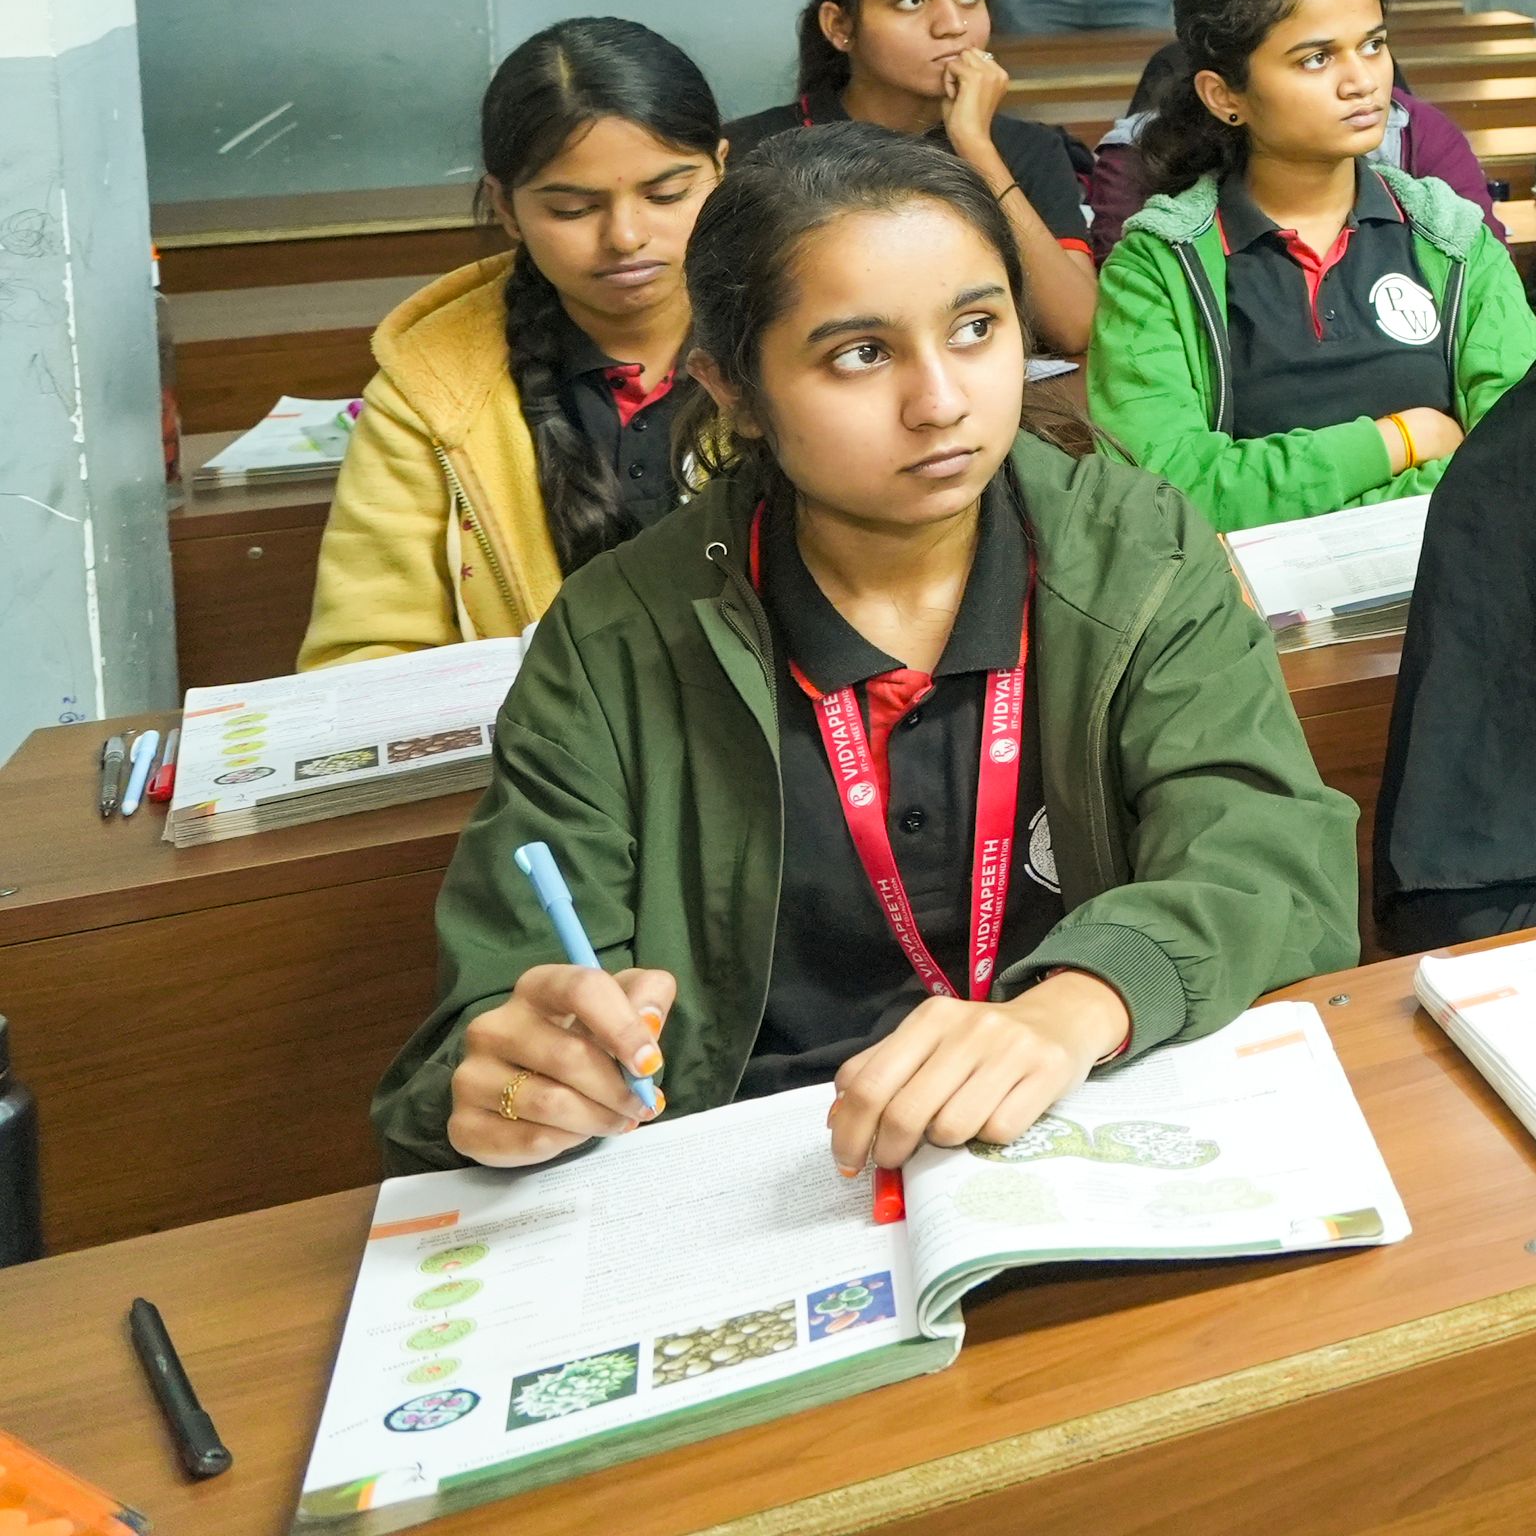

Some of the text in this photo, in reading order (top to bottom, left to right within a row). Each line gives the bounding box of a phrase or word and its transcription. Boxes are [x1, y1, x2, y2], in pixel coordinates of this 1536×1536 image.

[1384, 286, 1428, 335] PW
[822, 692, 859, 782] VIDYAPEE
[991, 668, 1012, 735] VIDYAP
[877, 878, 934, 978] VIDYAPEETH
[975, 838, 999, 957] VIDYAPEETH
